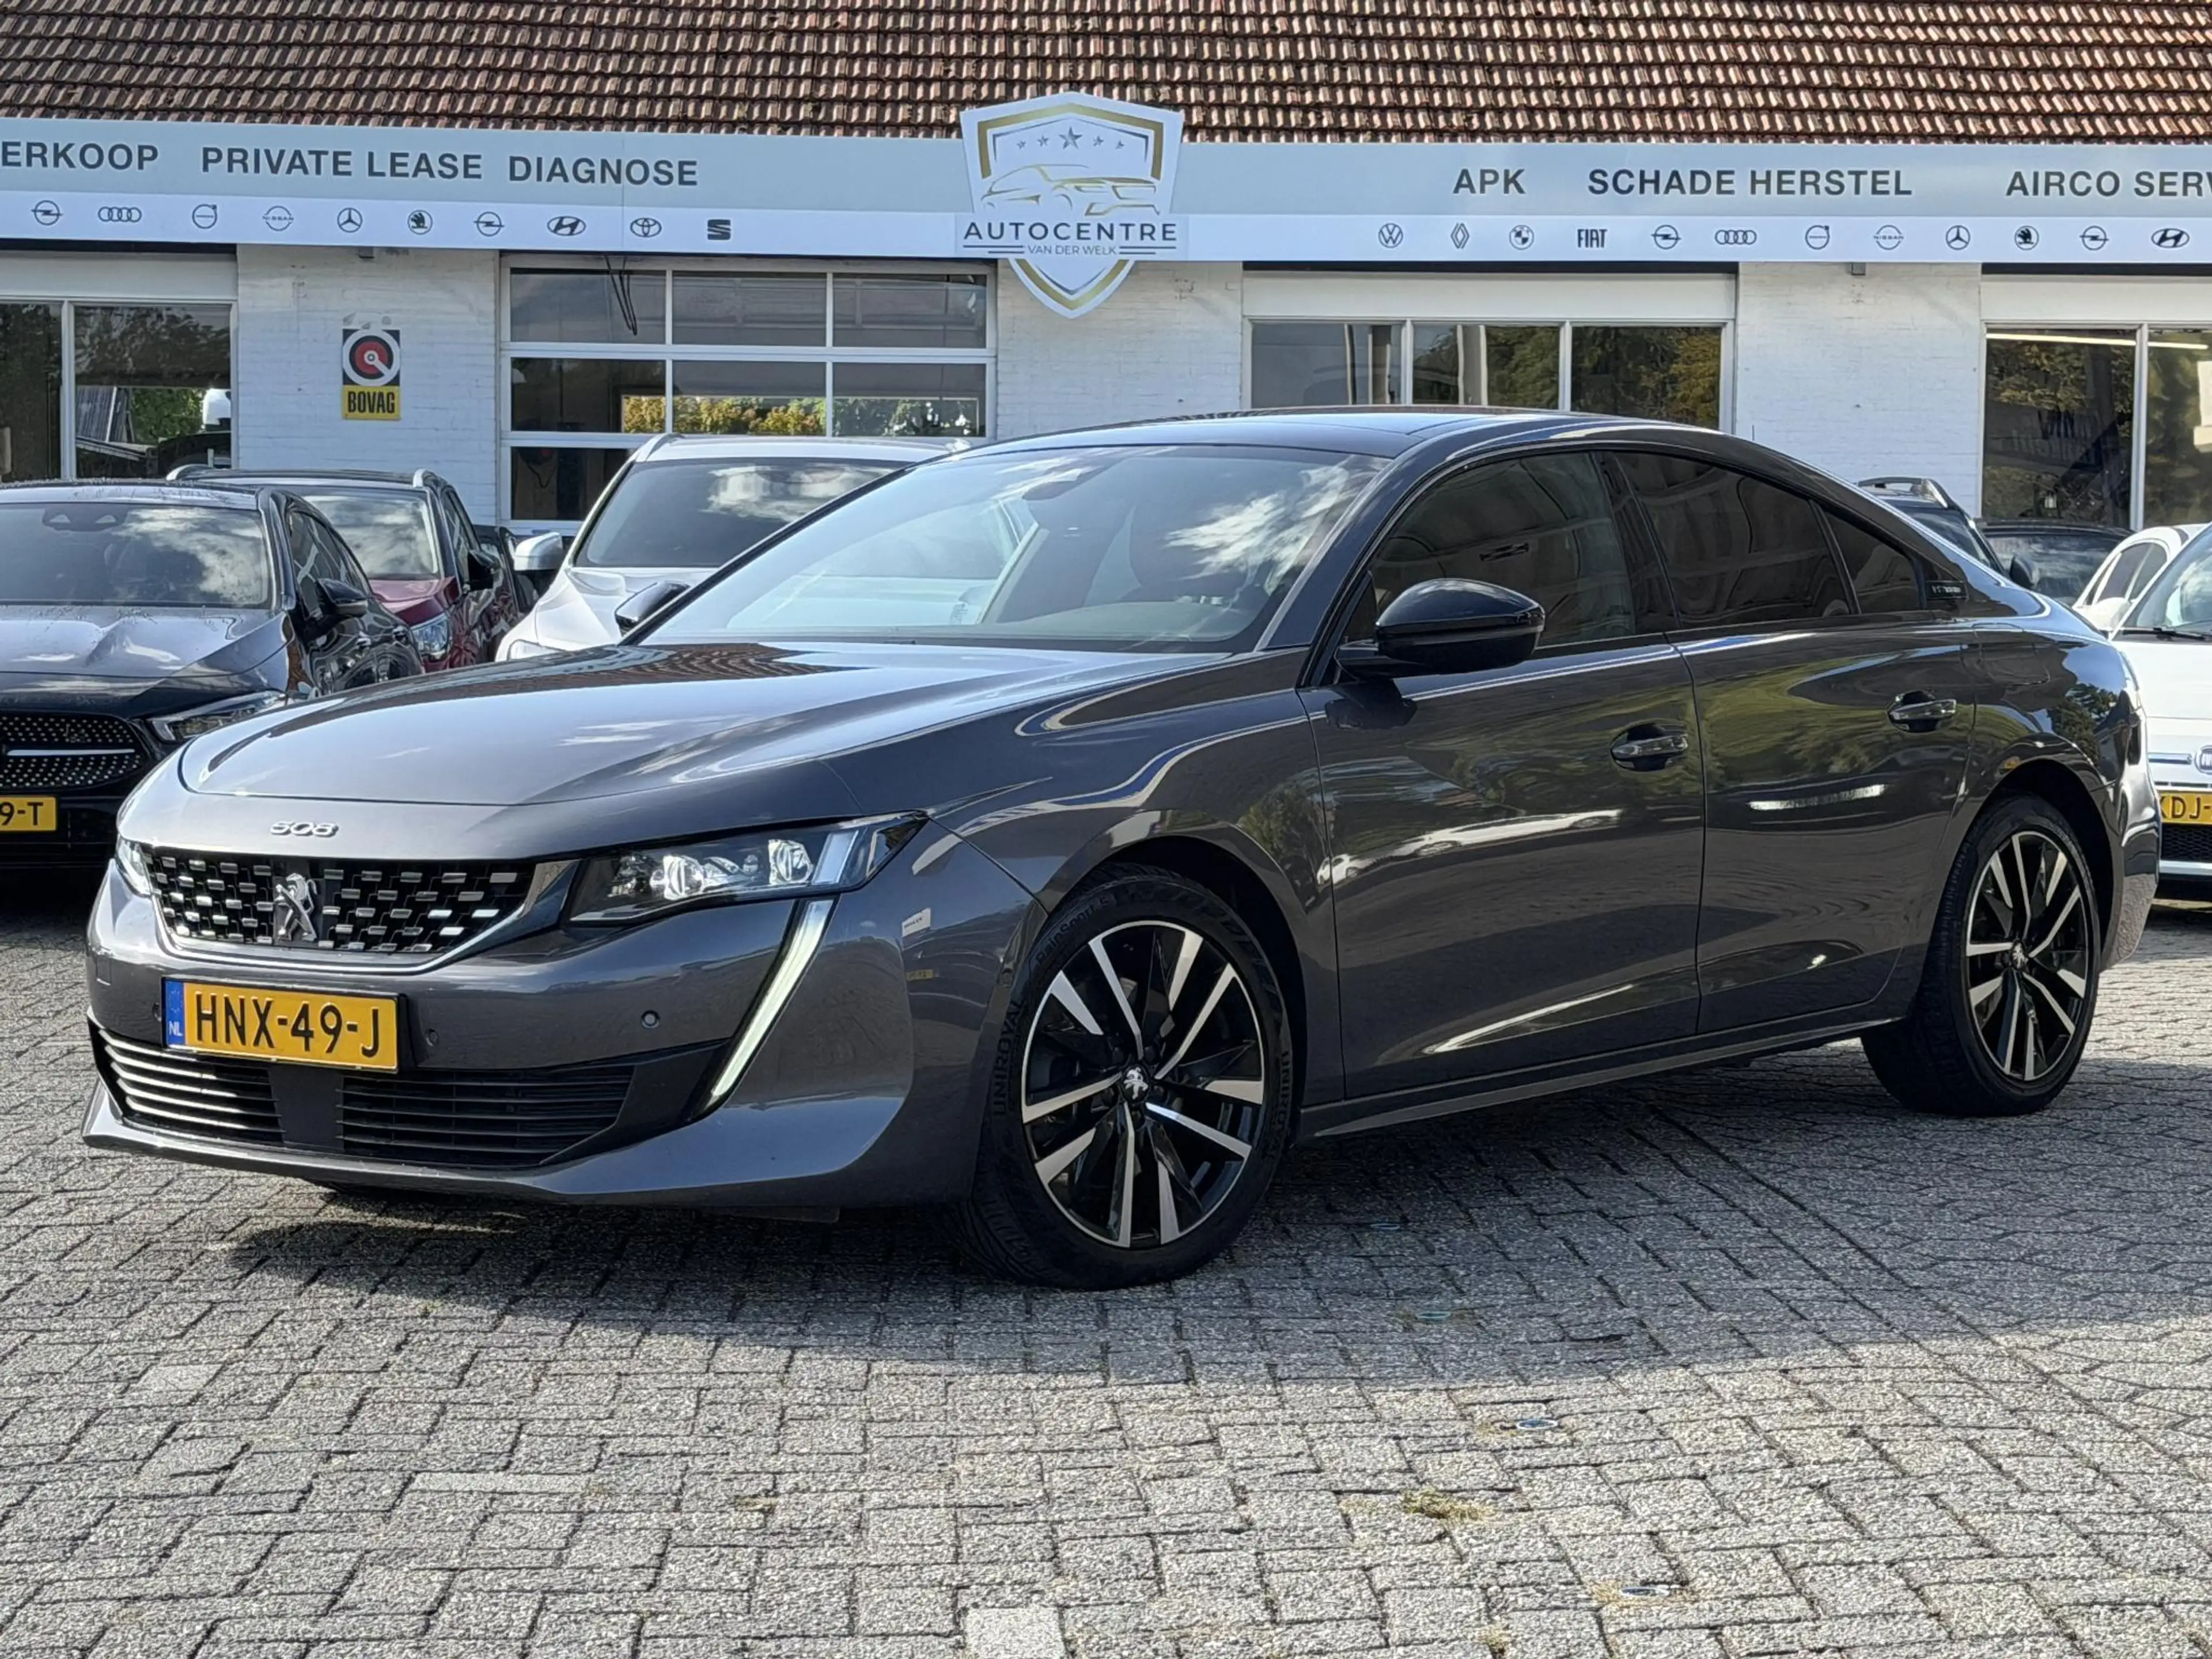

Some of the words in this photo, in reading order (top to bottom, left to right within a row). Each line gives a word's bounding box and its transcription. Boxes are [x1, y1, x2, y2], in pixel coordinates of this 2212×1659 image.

[2, 141, 158, 171] ERKOOP
[202, 147, 352, 176] PRIVATE
[368, 151, 482, 180] LEASE
[509, 156, 698, 186] DIAGNOSE
[1453, 168, 1525, 194] APK
[1588, 169, 1735, 195] SCHADE
[1750, 169, 1912, 196] HERSTEL
[2006, 171, 2120, 197] AIRCO
[2134, 171, 2212, 197] SER
[964, 222, 1176, 241] AUTOCENTRE
[1577, 229, 1608, 248] FIAT
[1028, 245, 1052, 254] VAN
[1055, 245, 1080, 255] DER
[1082, 245, 1116, 256] WELK
[347, 391, 395, 414] BOVAG
[270, 821, 339, 838] 508
[169, 1021, 183, 1036] NL
[195, 991, 381, 1058] HNX-49-J
[992, 999, 1024, 1116] UNIROYAL
